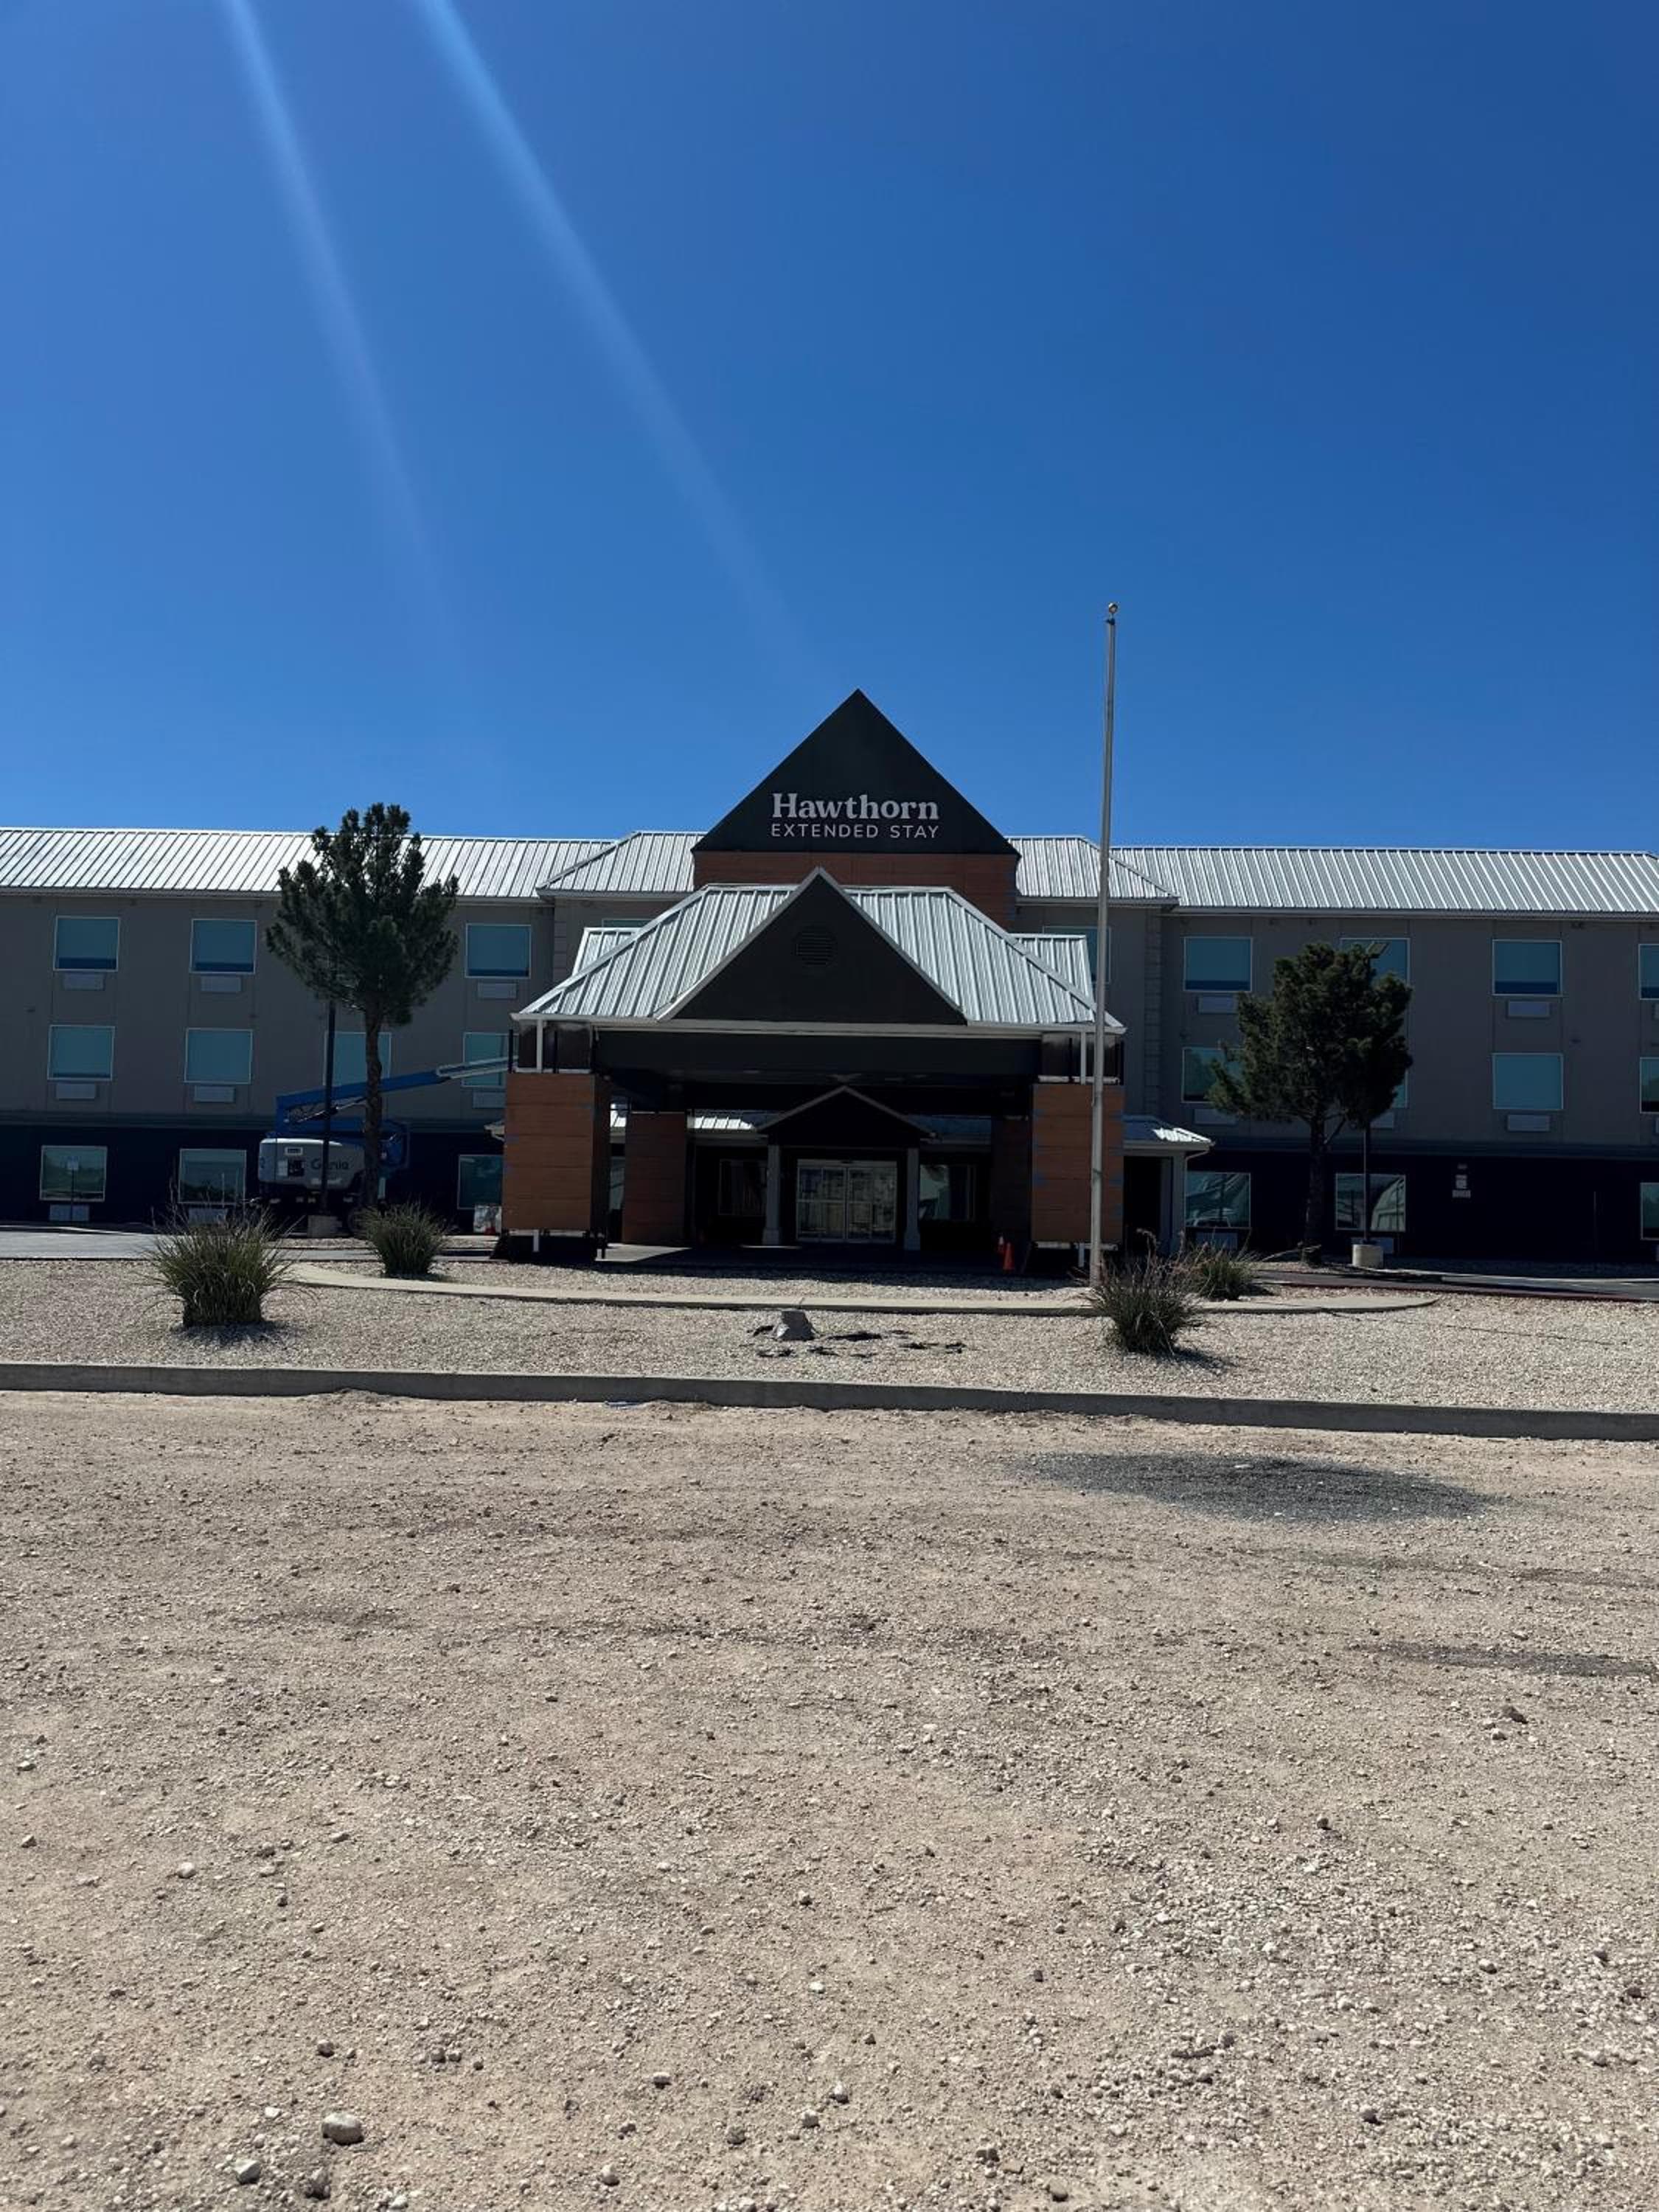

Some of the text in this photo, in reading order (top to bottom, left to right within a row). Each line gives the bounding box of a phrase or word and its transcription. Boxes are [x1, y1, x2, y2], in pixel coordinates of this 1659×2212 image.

[772, 793, 939, 820] Hawthorn
[771, 824, 939, 839] EXTENDED STAY
[311, 1158, 349, 1169] Gnie
